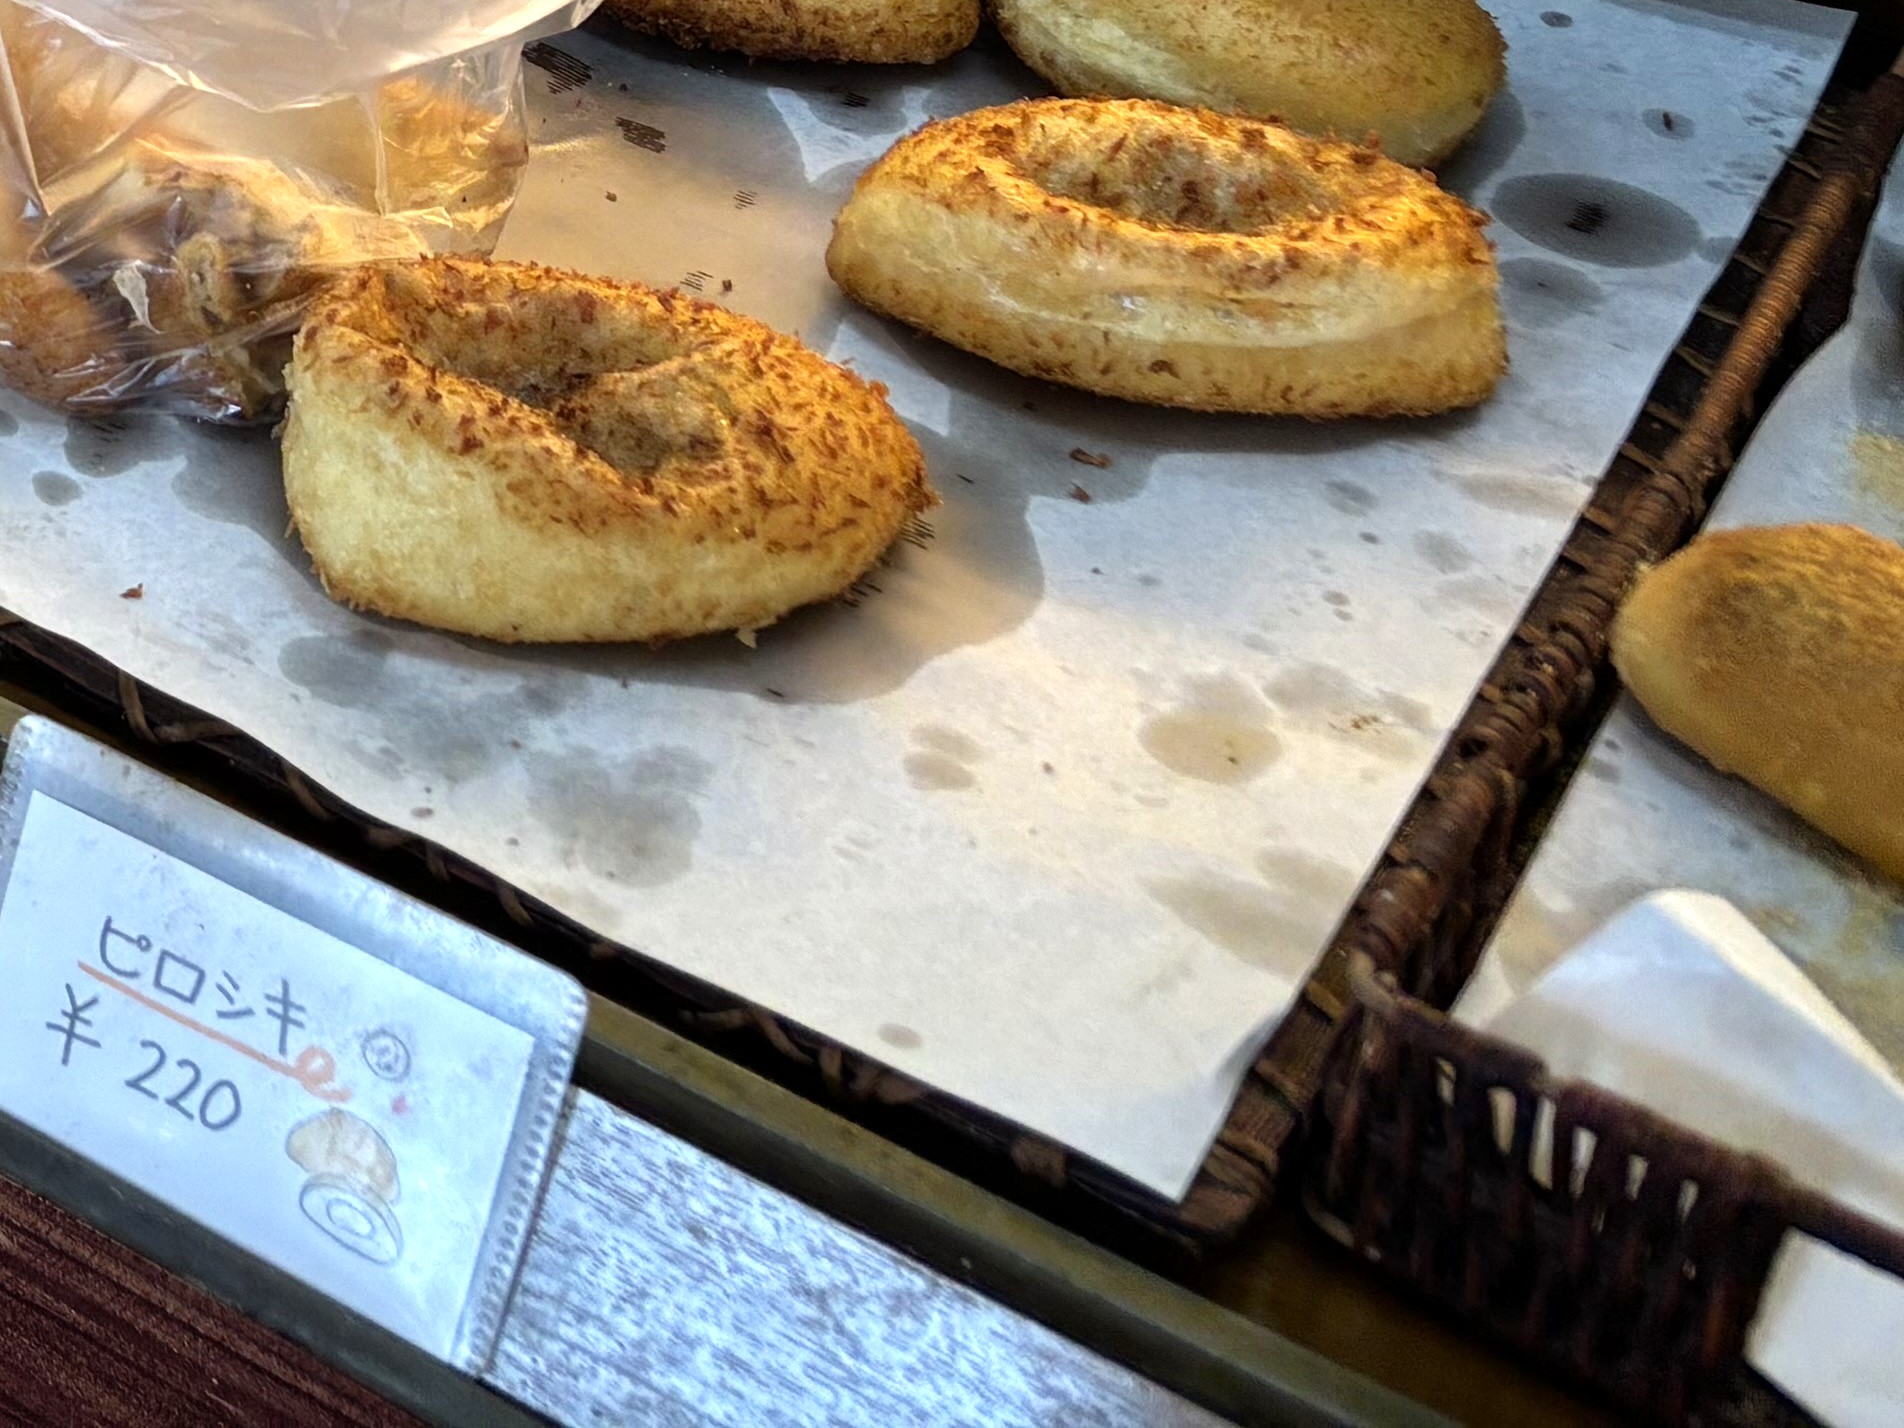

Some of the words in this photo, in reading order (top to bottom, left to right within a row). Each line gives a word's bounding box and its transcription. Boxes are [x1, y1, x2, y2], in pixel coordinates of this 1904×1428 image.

[98, 915, 308, 1057] ピロシキ
[125, 1039, 242, 1132] 220
